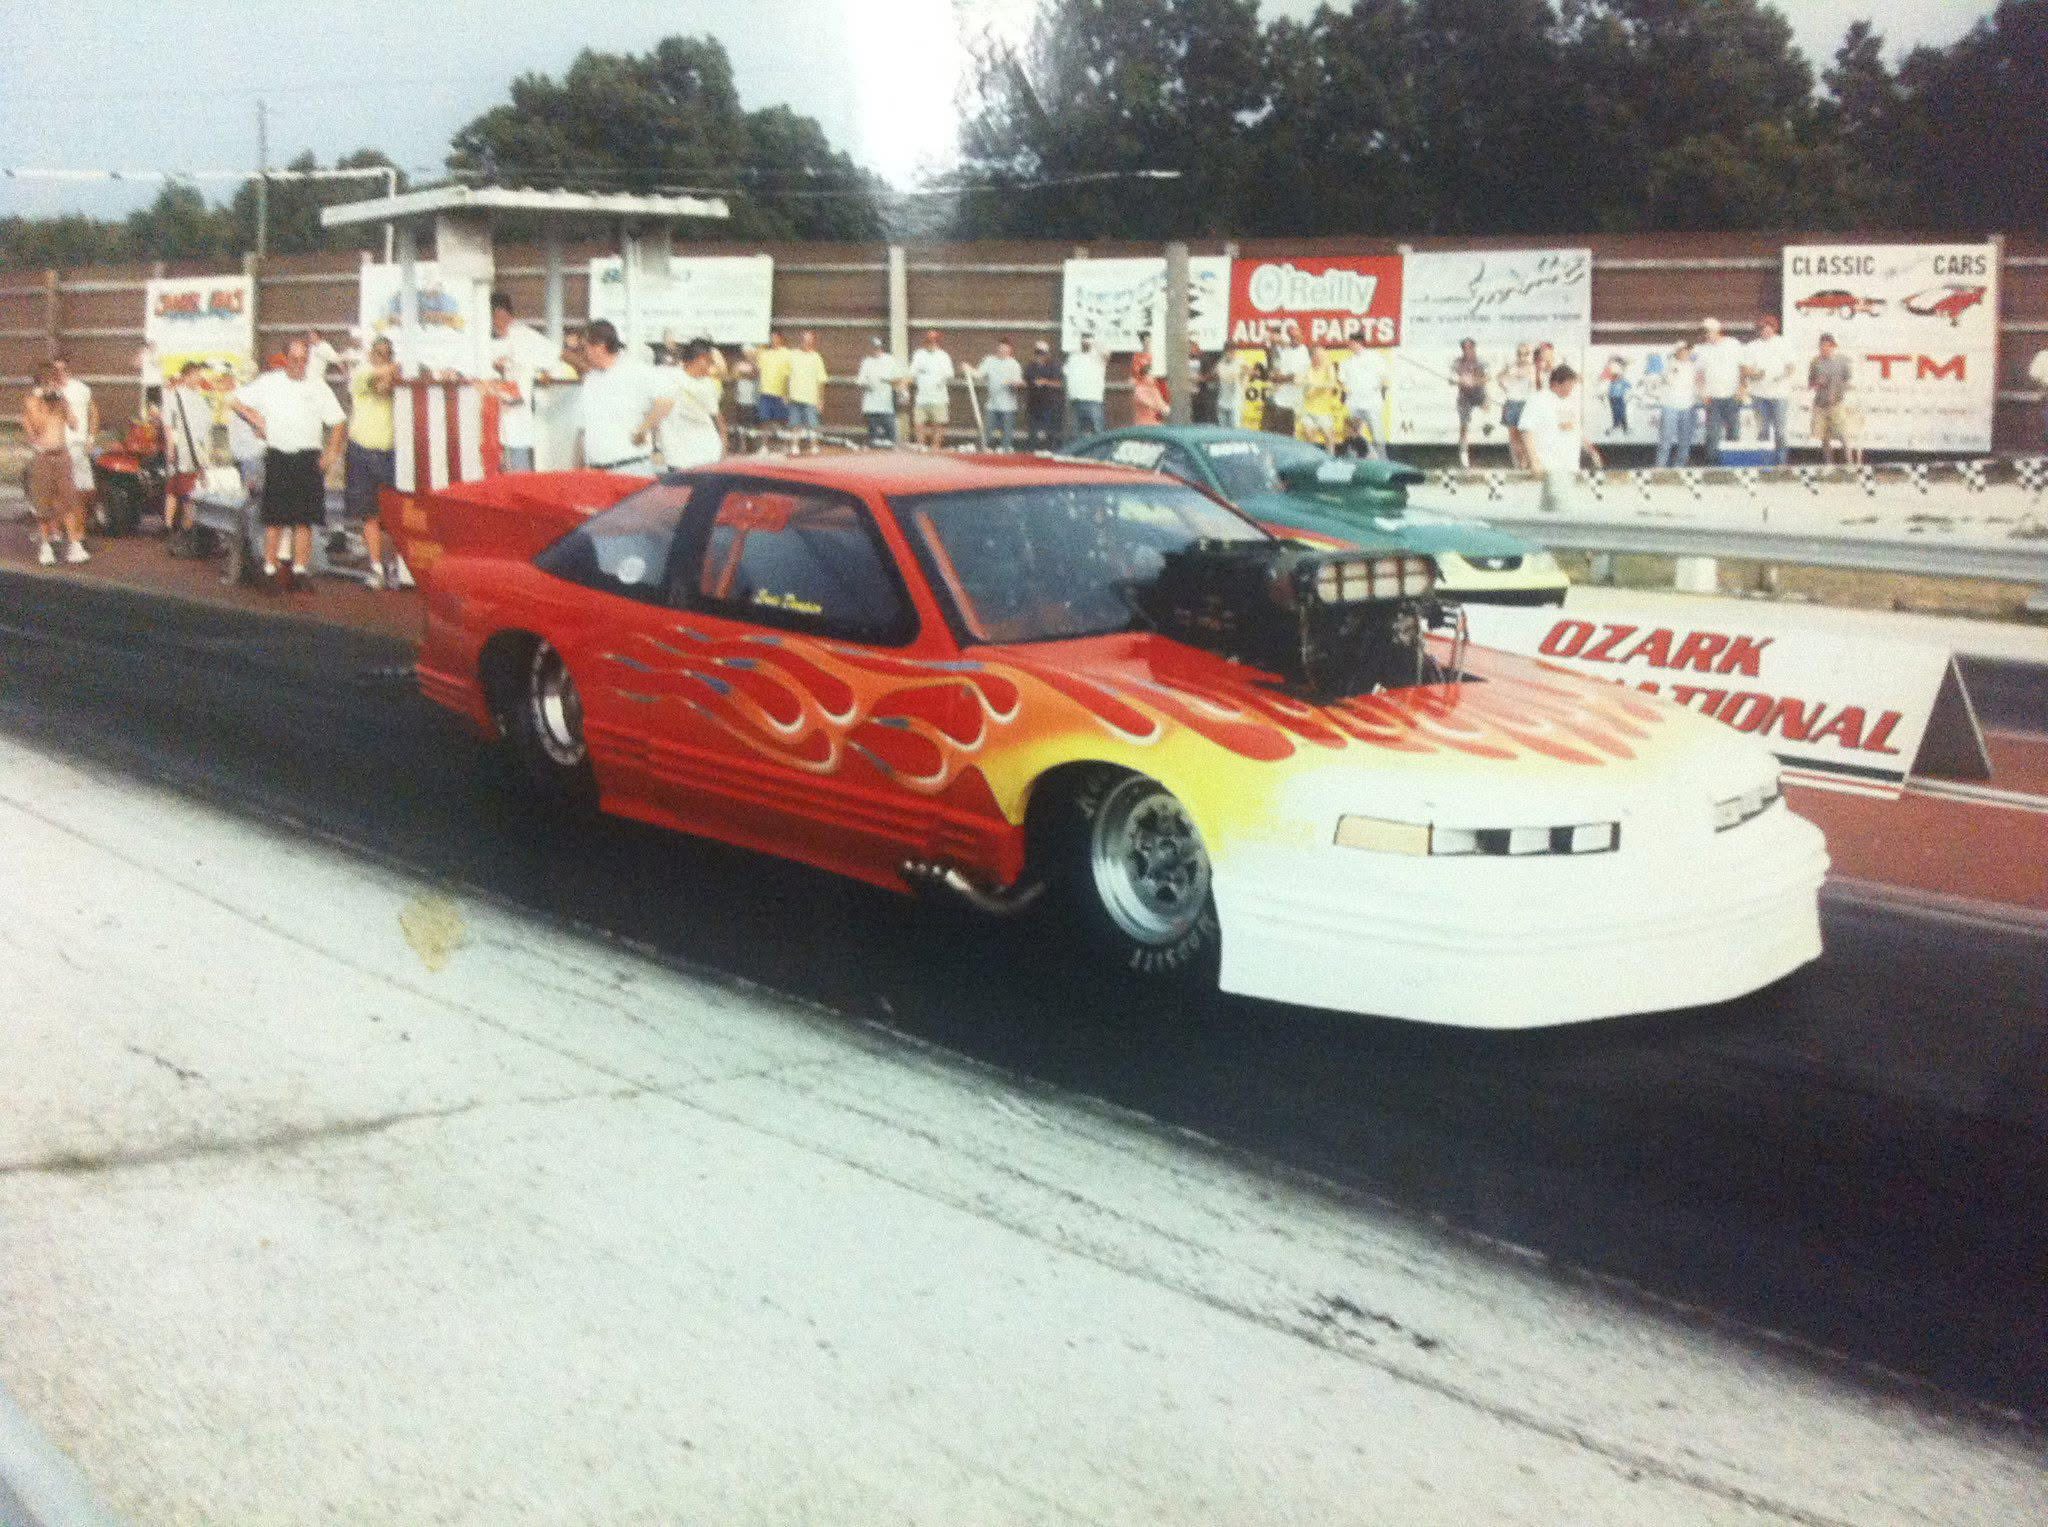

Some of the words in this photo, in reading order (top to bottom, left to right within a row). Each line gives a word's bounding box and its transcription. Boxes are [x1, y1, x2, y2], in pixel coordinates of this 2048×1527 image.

[1791, 254, 1876, 276] CLASSIC
[1932, 253, 1988, 276] CARS
[1311, 317, 1395, 343] PARTS
[1537, 618, 1776, 678] OZARK
[1616, 677, 1904, 755] TIONAL
